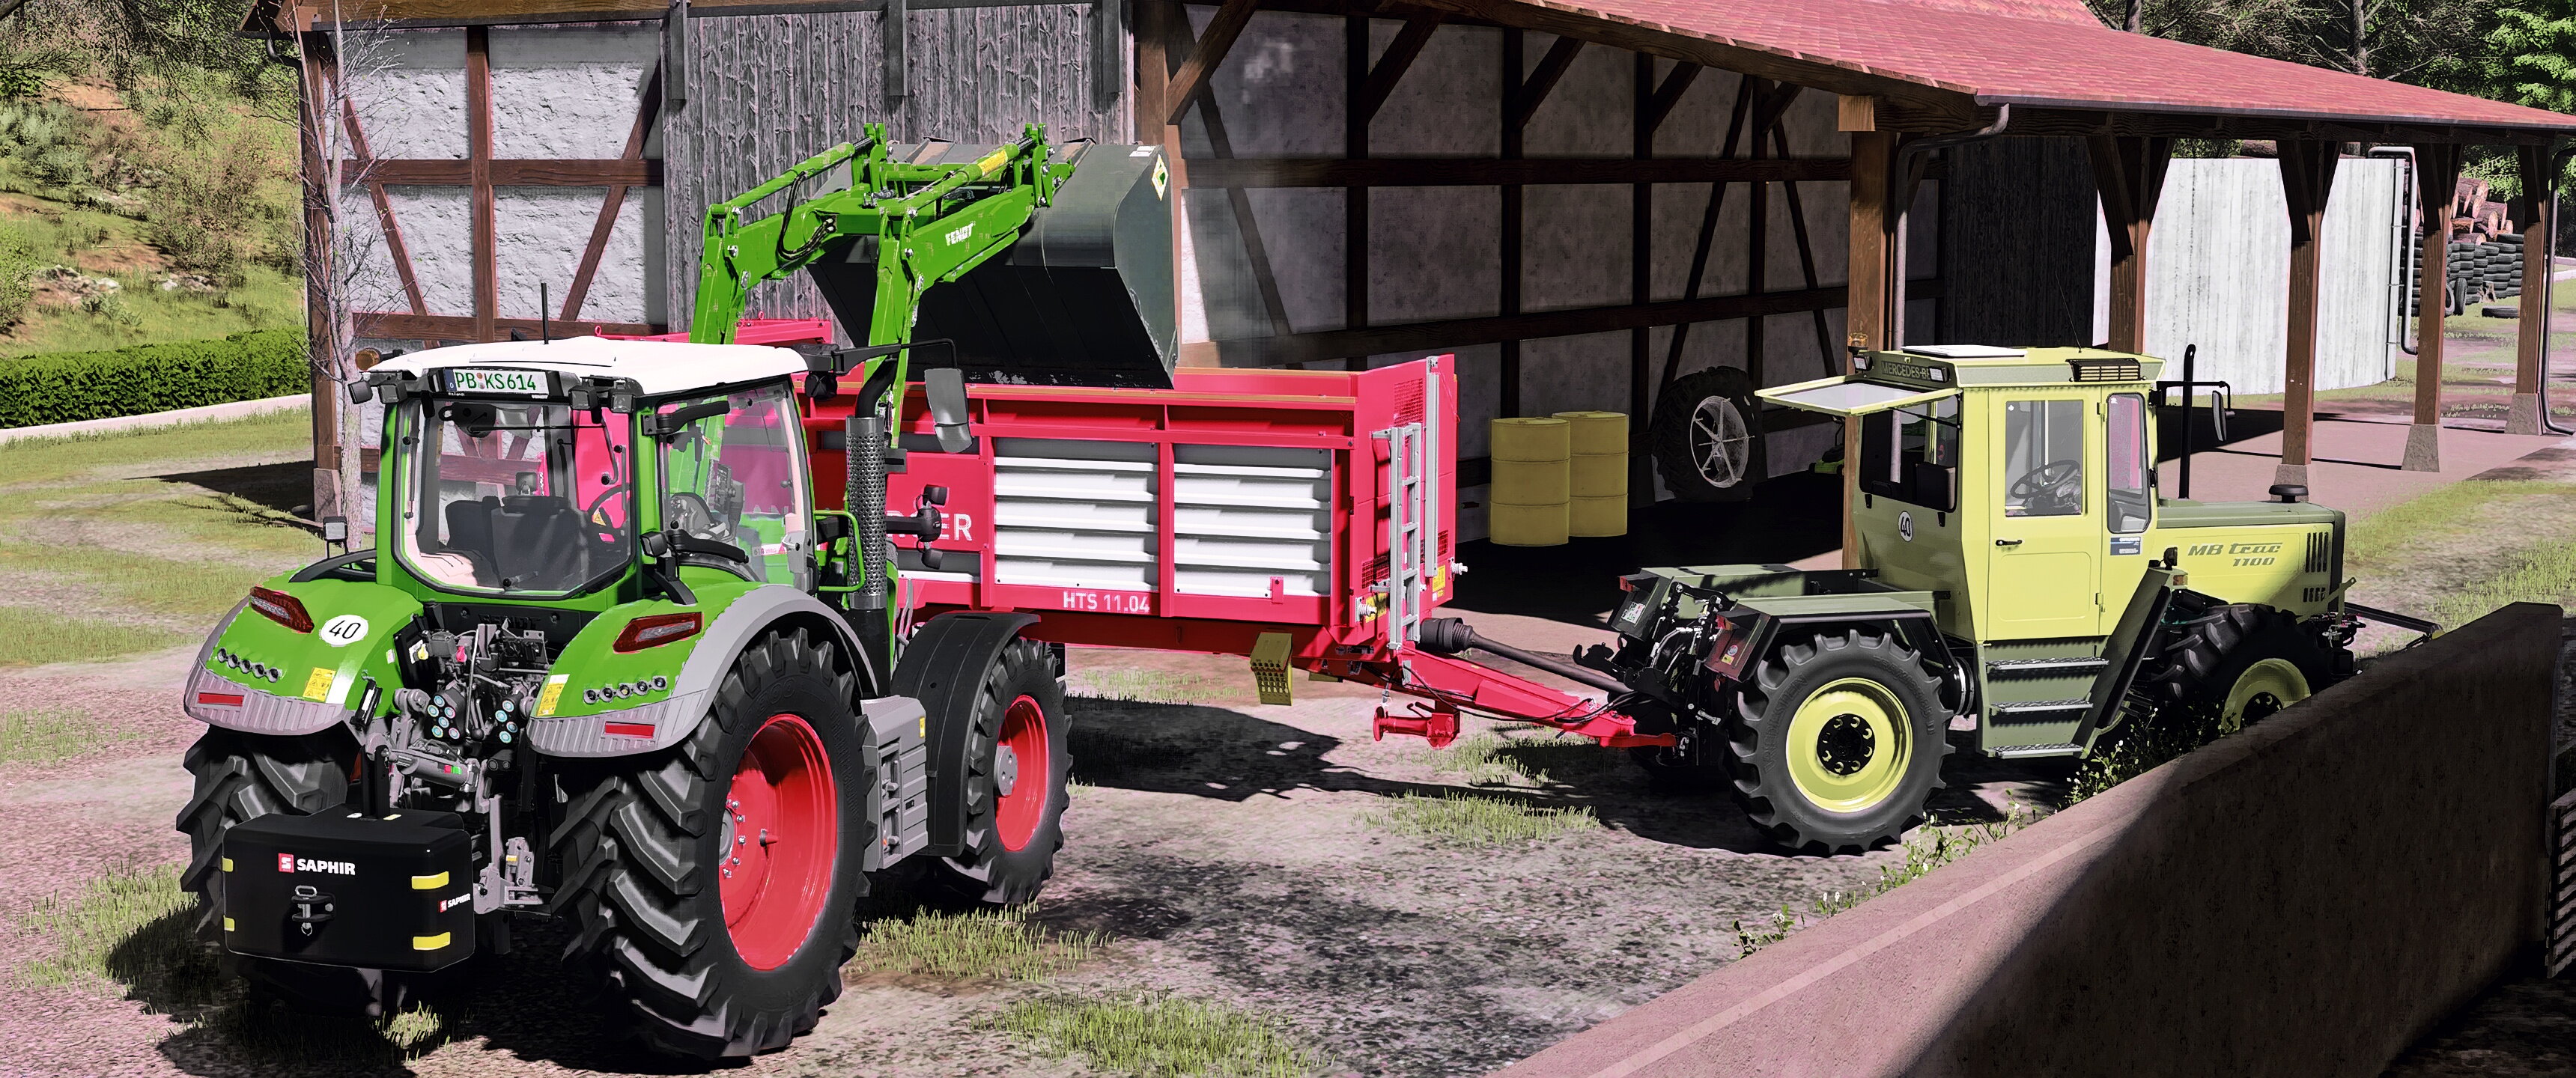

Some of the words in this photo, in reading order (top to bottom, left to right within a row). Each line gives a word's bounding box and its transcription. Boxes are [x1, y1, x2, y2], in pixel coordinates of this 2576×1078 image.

[945, 222, 975, 246] FENDT
[455, 371, 477, 389] PB
[1900, 516, 1911, 538] 40
[2187, 544, 2224, 556] MB
[2229, 542, 2283, 555] trac
[2232, 557, 2275, 567] 1100
[1063, 591, 1098, 610] HTS
[1103, 594, 1150, 613] 11.04
[328, 619, 362, 639] 40
[297, 858, 356, 876] SAPHIR
[447, 893, 471, 908] SAPHIR
